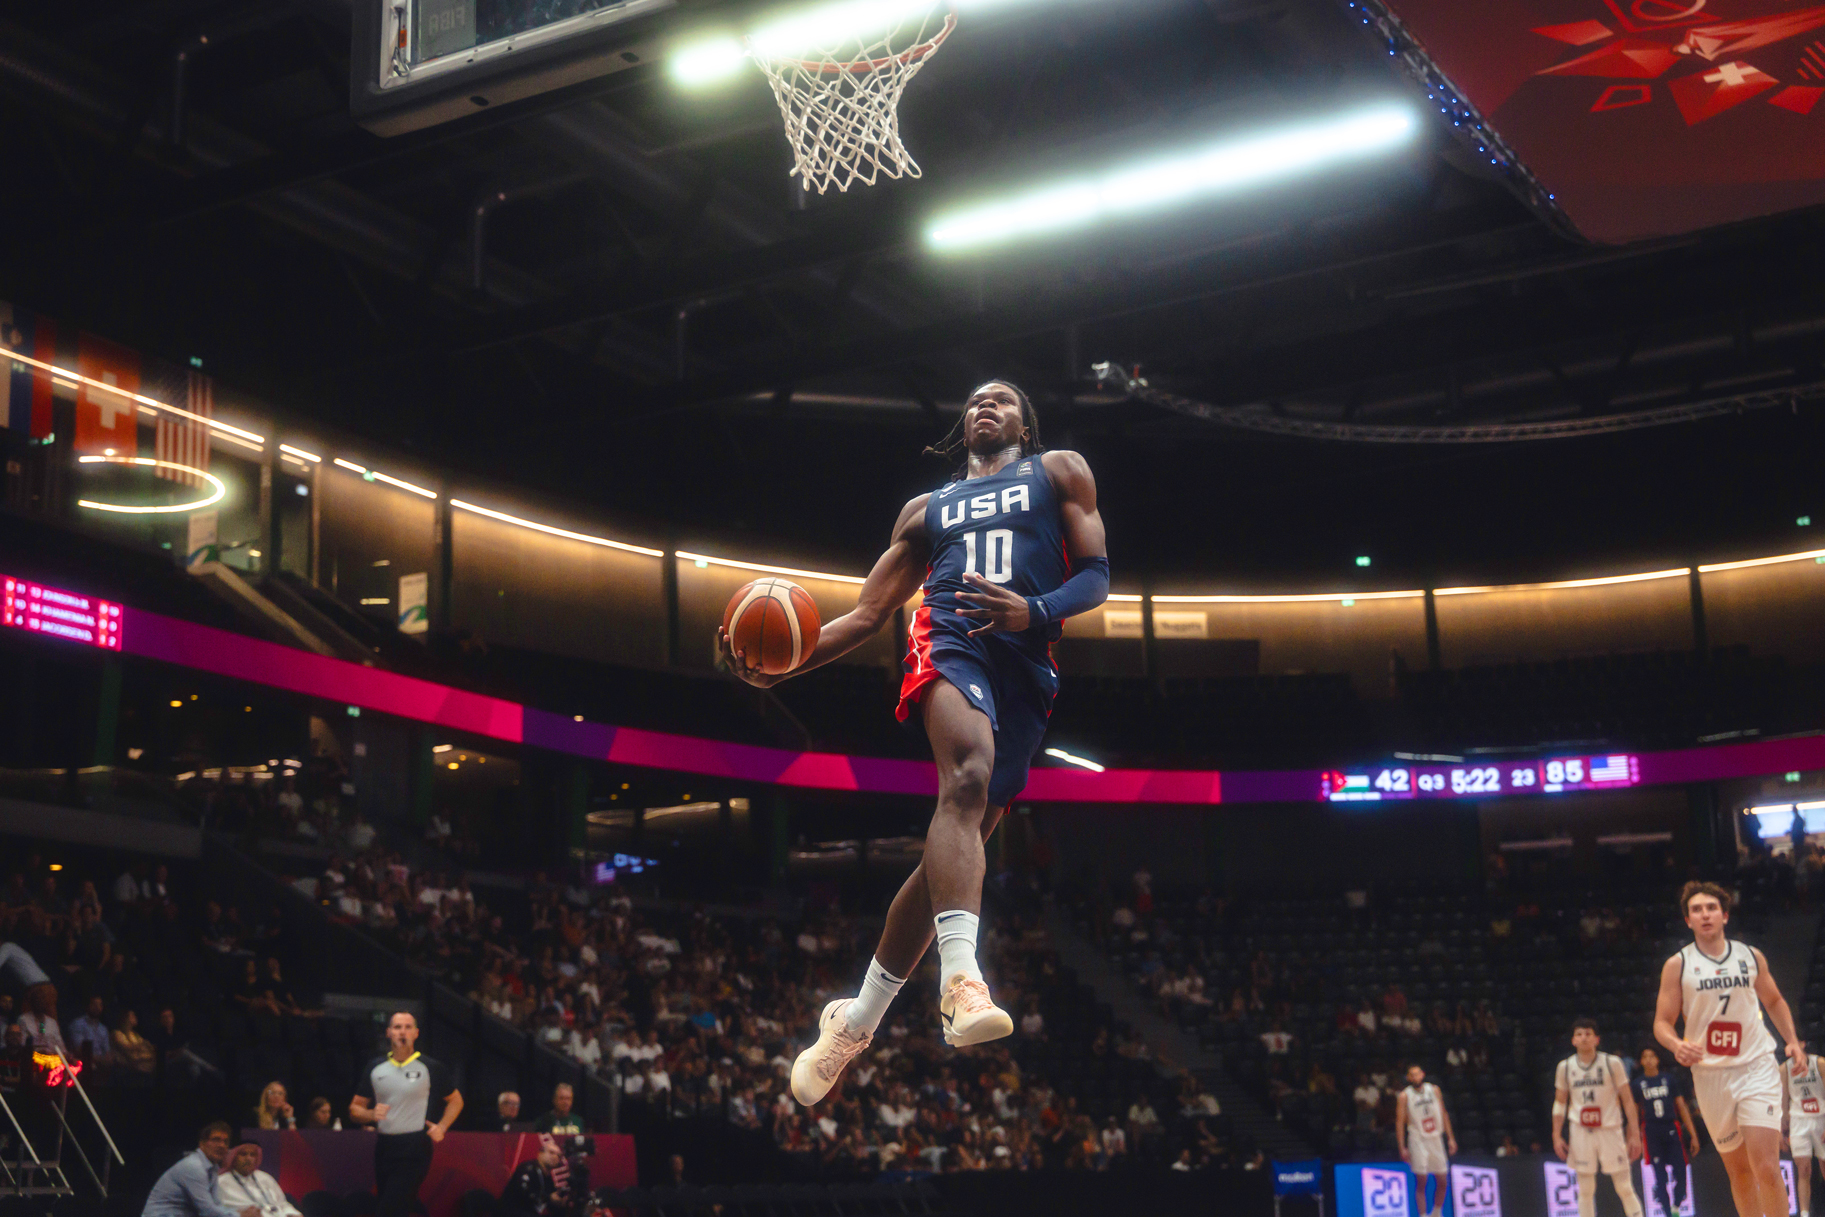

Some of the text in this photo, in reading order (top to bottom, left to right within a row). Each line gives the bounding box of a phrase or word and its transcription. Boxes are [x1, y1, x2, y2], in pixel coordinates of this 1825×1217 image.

[941, 484, 1030, 529] USA
[962, 528, 1014, 584] 10
[1374, 759, 1585, 794] 42 Q3 5:22 23 85
[1696, 975, 1750, 991] JORDAN
[1719, 994, 1731, 1015] 7
[1711, 1030, 1738, 1048] CFI
[1371, 1175, 1403, 1210] 20
[1462, 1172, 1495, 1208] 20
